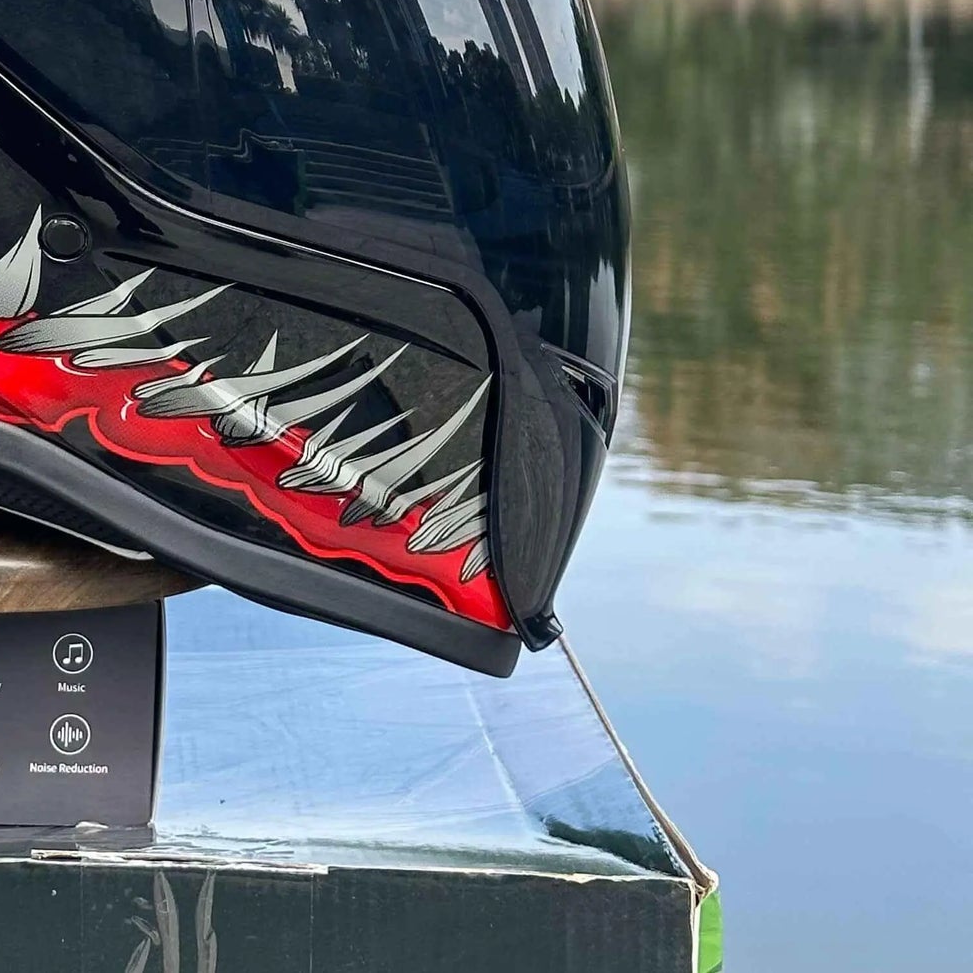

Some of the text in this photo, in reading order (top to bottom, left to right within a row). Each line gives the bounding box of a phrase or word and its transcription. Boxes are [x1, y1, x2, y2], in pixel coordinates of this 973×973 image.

[57, 683, 86, 692] Music
[29, 763, 109, 774] Noise Reduction
